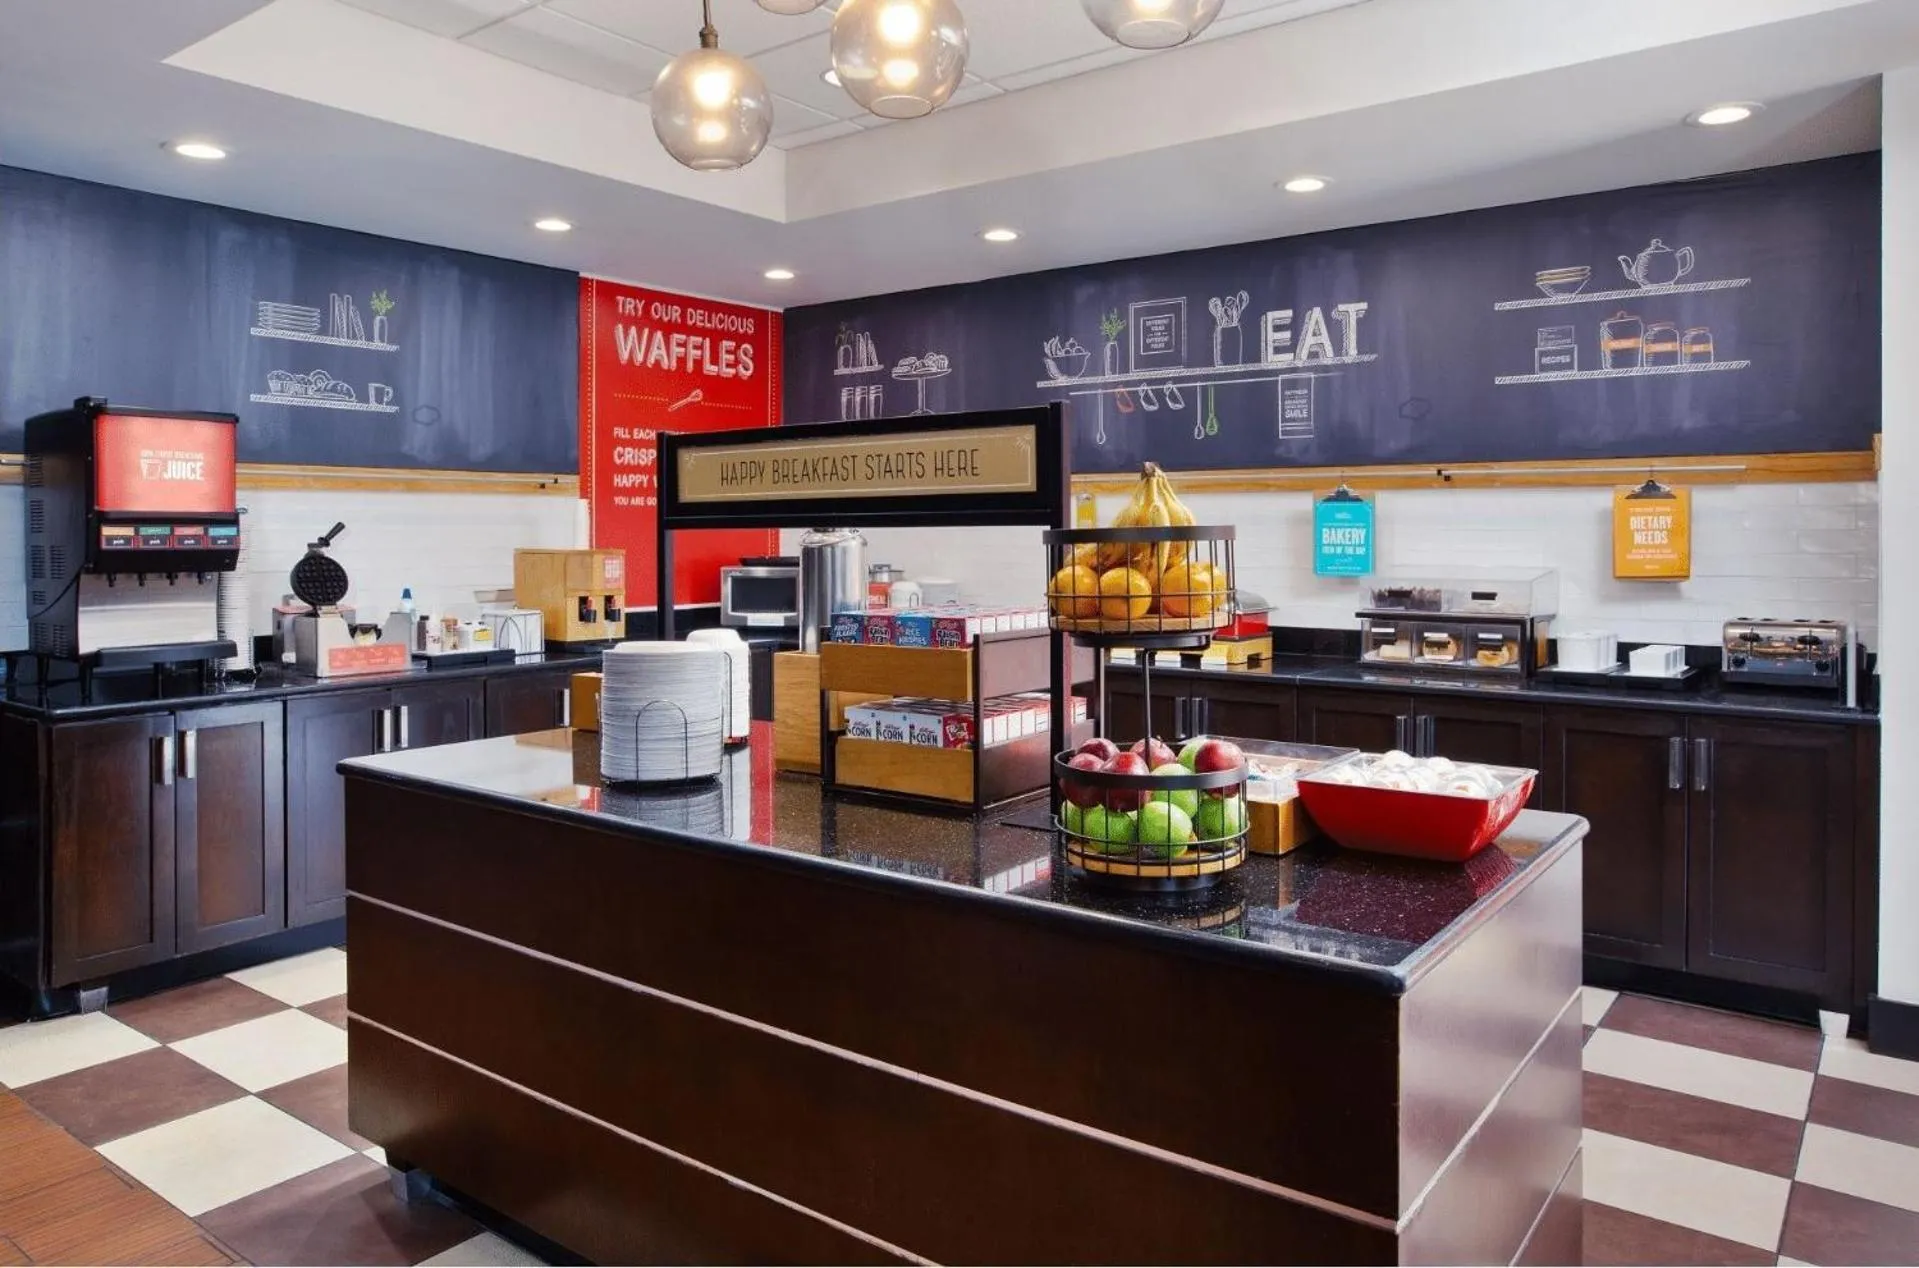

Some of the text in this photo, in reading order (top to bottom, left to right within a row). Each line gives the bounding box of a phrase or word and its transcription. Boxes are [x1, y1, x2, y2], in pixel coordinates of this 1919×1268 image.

[616, 296, 755, 334] TRY OUR DELICIOUS
[1261, 302, 1368, 367] EAT
[614, 323, 755, 381] WAFFLES
[614, 427, 631, 440] FILL
[633, 428, 656, 441] EACH
[162, 460, 205, 481] JUICE
[721, 448, 981, 487] HAPPY BREAKFAST STARTS HERE
[613, 474, 649, 489] HAPPY
[613, 497, 629, 507] YOU
[630, 497, 645, 507] ARE
[1630, 515, 1673, 530] DIETARY
[1322, 527, 1366, 545] BAKERY
[1633, 530, 1669, 545] NEEDS
[851, 726, 871, 737] CORN
[883, 729, 903, 740] CORN
[916, 733, 938, 744] CORN
